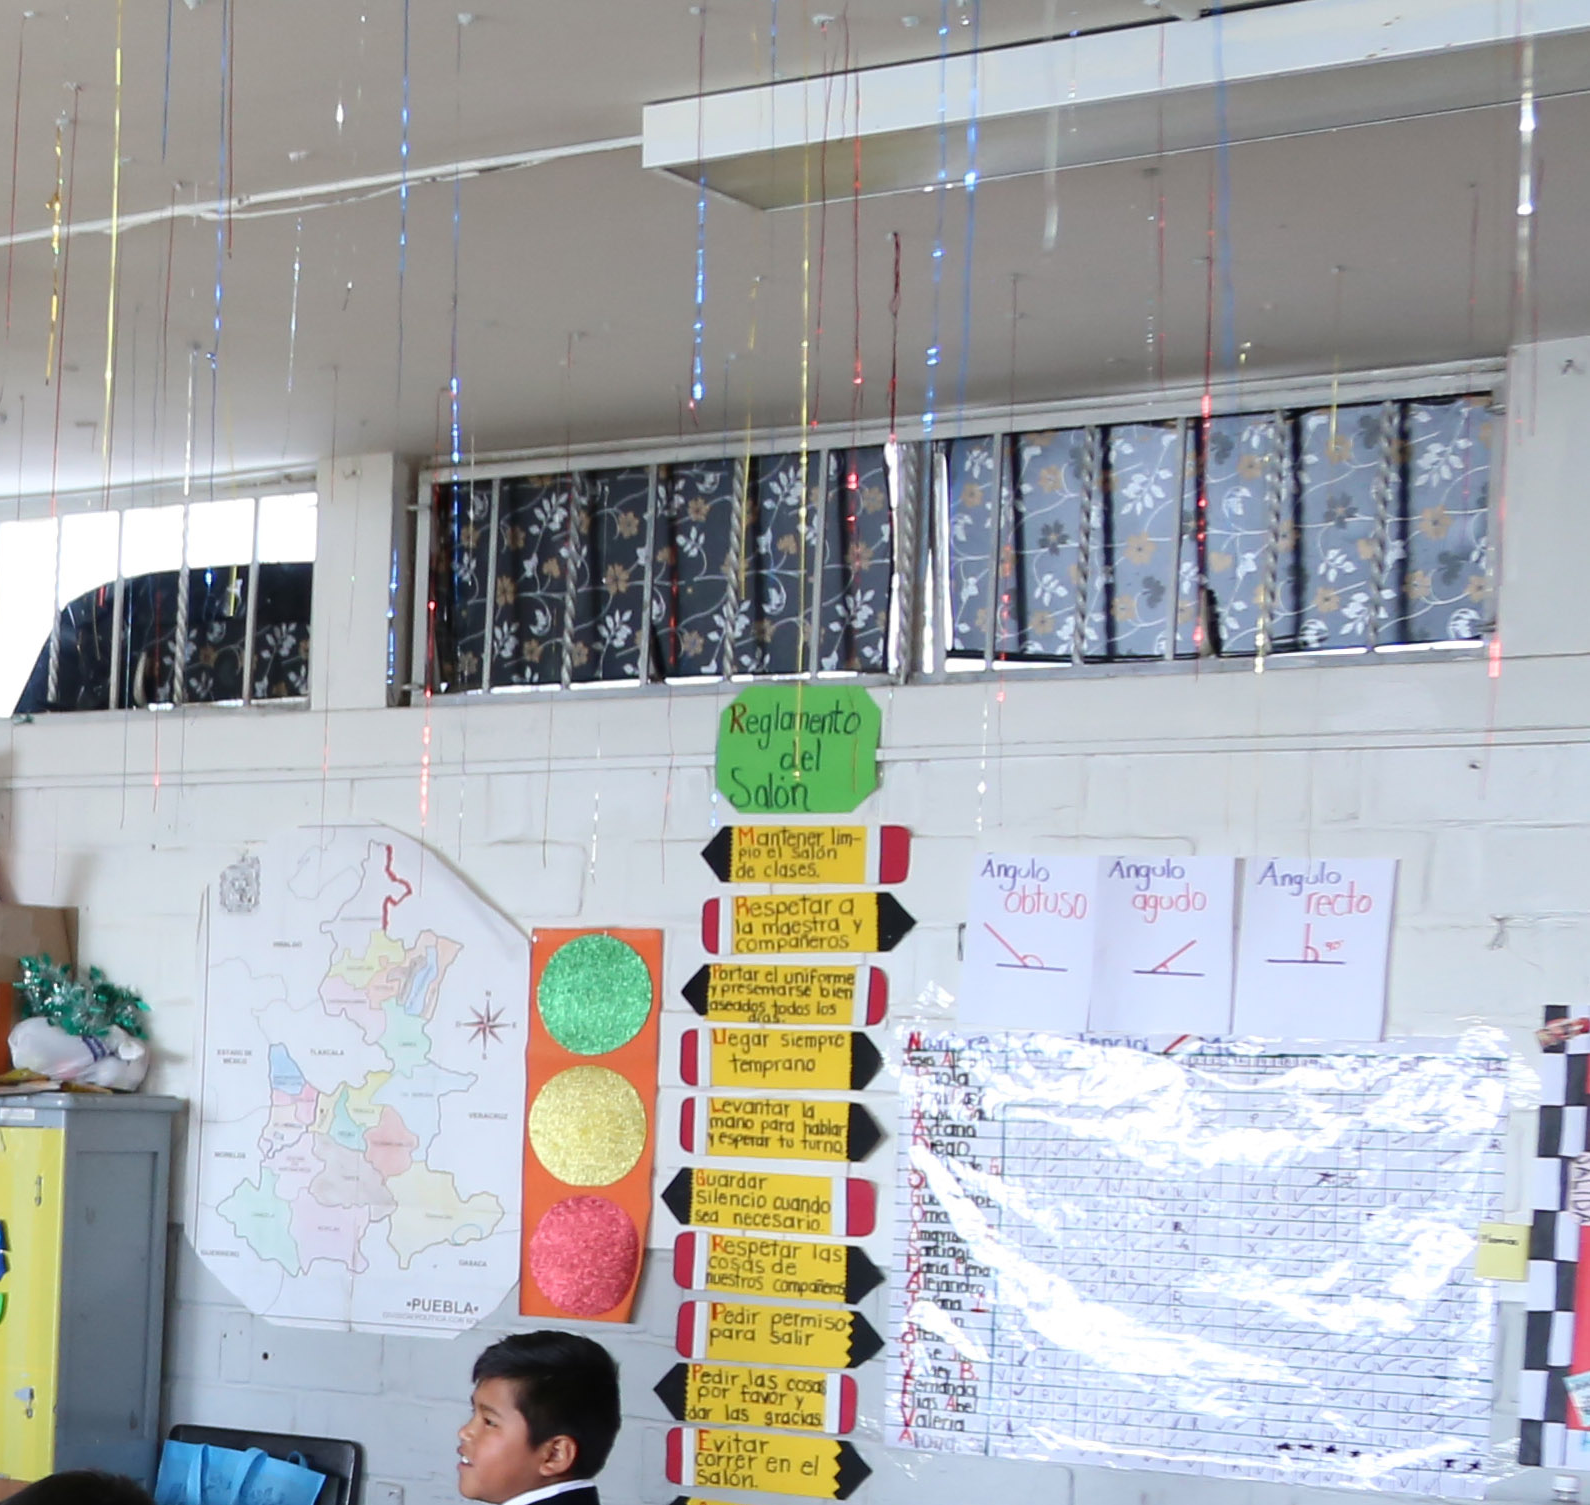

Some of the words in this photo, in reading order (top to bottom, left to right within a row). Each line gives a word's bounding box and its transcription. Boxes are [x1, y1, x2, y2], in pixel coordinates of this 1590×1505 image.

[729, 699, 862, 751] Reglamento
[779, 737, 822, 772] del
[728, 766, 812, 812] Salón
[737, 826, 827, 846] Mantener
[737, 846, 761, 863] pio
[766, 845, 783, 860] el
[735, 860, 756, 879] de
[980, 853, 1051, 893] Ángulo
[1108, 854, 1186, 891] Ángulo
[1257, 856, 1342, 896] Ángulo
[734, 894, 830, 921] Respetar
[838, 897, 855, 916] a
[1003, 883, 1089, 920] obtuso
[1131, 882, 1208, 924] agudo
[1303, 879, 1374, 916] recto
[735, 919, 754, 935] la
[761, 916, 840, 937] maestra
[852, 919, 863, 933] y
[735, 933, 849, 953] compañeros
[712, 963, 761, 984] Portar
[765, 966, 778, 984] el
[783, 968, 855, 988] uniforme
[720, 982, 812, 999] presentarse
[819, 982, 854, 1000] bien
[708, 1000, 767, 1014] aseados
[771, 1001, 811, 1017] todos
[816, 1001, 837, 1016] los
[780, 1030, 845, 1053] siempre
[729, 1052, 817, 1079] temprano
[710, 1097, 790, 1118] Levantar
[801, 1101, 816, 1119] la
[709, 1115, 755, 1130] mano
[760, 1119, 796, 1134] para
[803, 1117, 847, 1138] hablar
[718, 1131, 773, 1150] esperar
[778, 1134, 795, 1149] tu
[695, 1168, 768, 1191] Guardar
[695, 1209, 720, 1224] sea
[772, 1195, 832, 1215] cuando
[711, 1234, 802, 1260] Respetar
[812, 1243, 843, 1263] las
[707, 1254, 766, 1274] cosas
[771, 1258, 798, 1277] de
[706, 1269, 765, 1290] nuestros
[711, 1301, 762, 1326] Pedir
[770, 1310, 848, 1333] permiso
[709, 1326, 757, 1347] para
[691, 1362, 741, 1387] Pedir
[748, 1367, 779, 1391] las
[696, 1384, 731, 1401] por
[740, 1383, 789, 1406] favor
[794, 1394, 805, 1410] y
[724, 1404, 750, 1423] las
[697, 1428, 770, 1455] Evitar
[694, 1450, 759, 1471] correr
[764, 1456, 791, 1474] en
[799, 1455, 820, 1477] el
